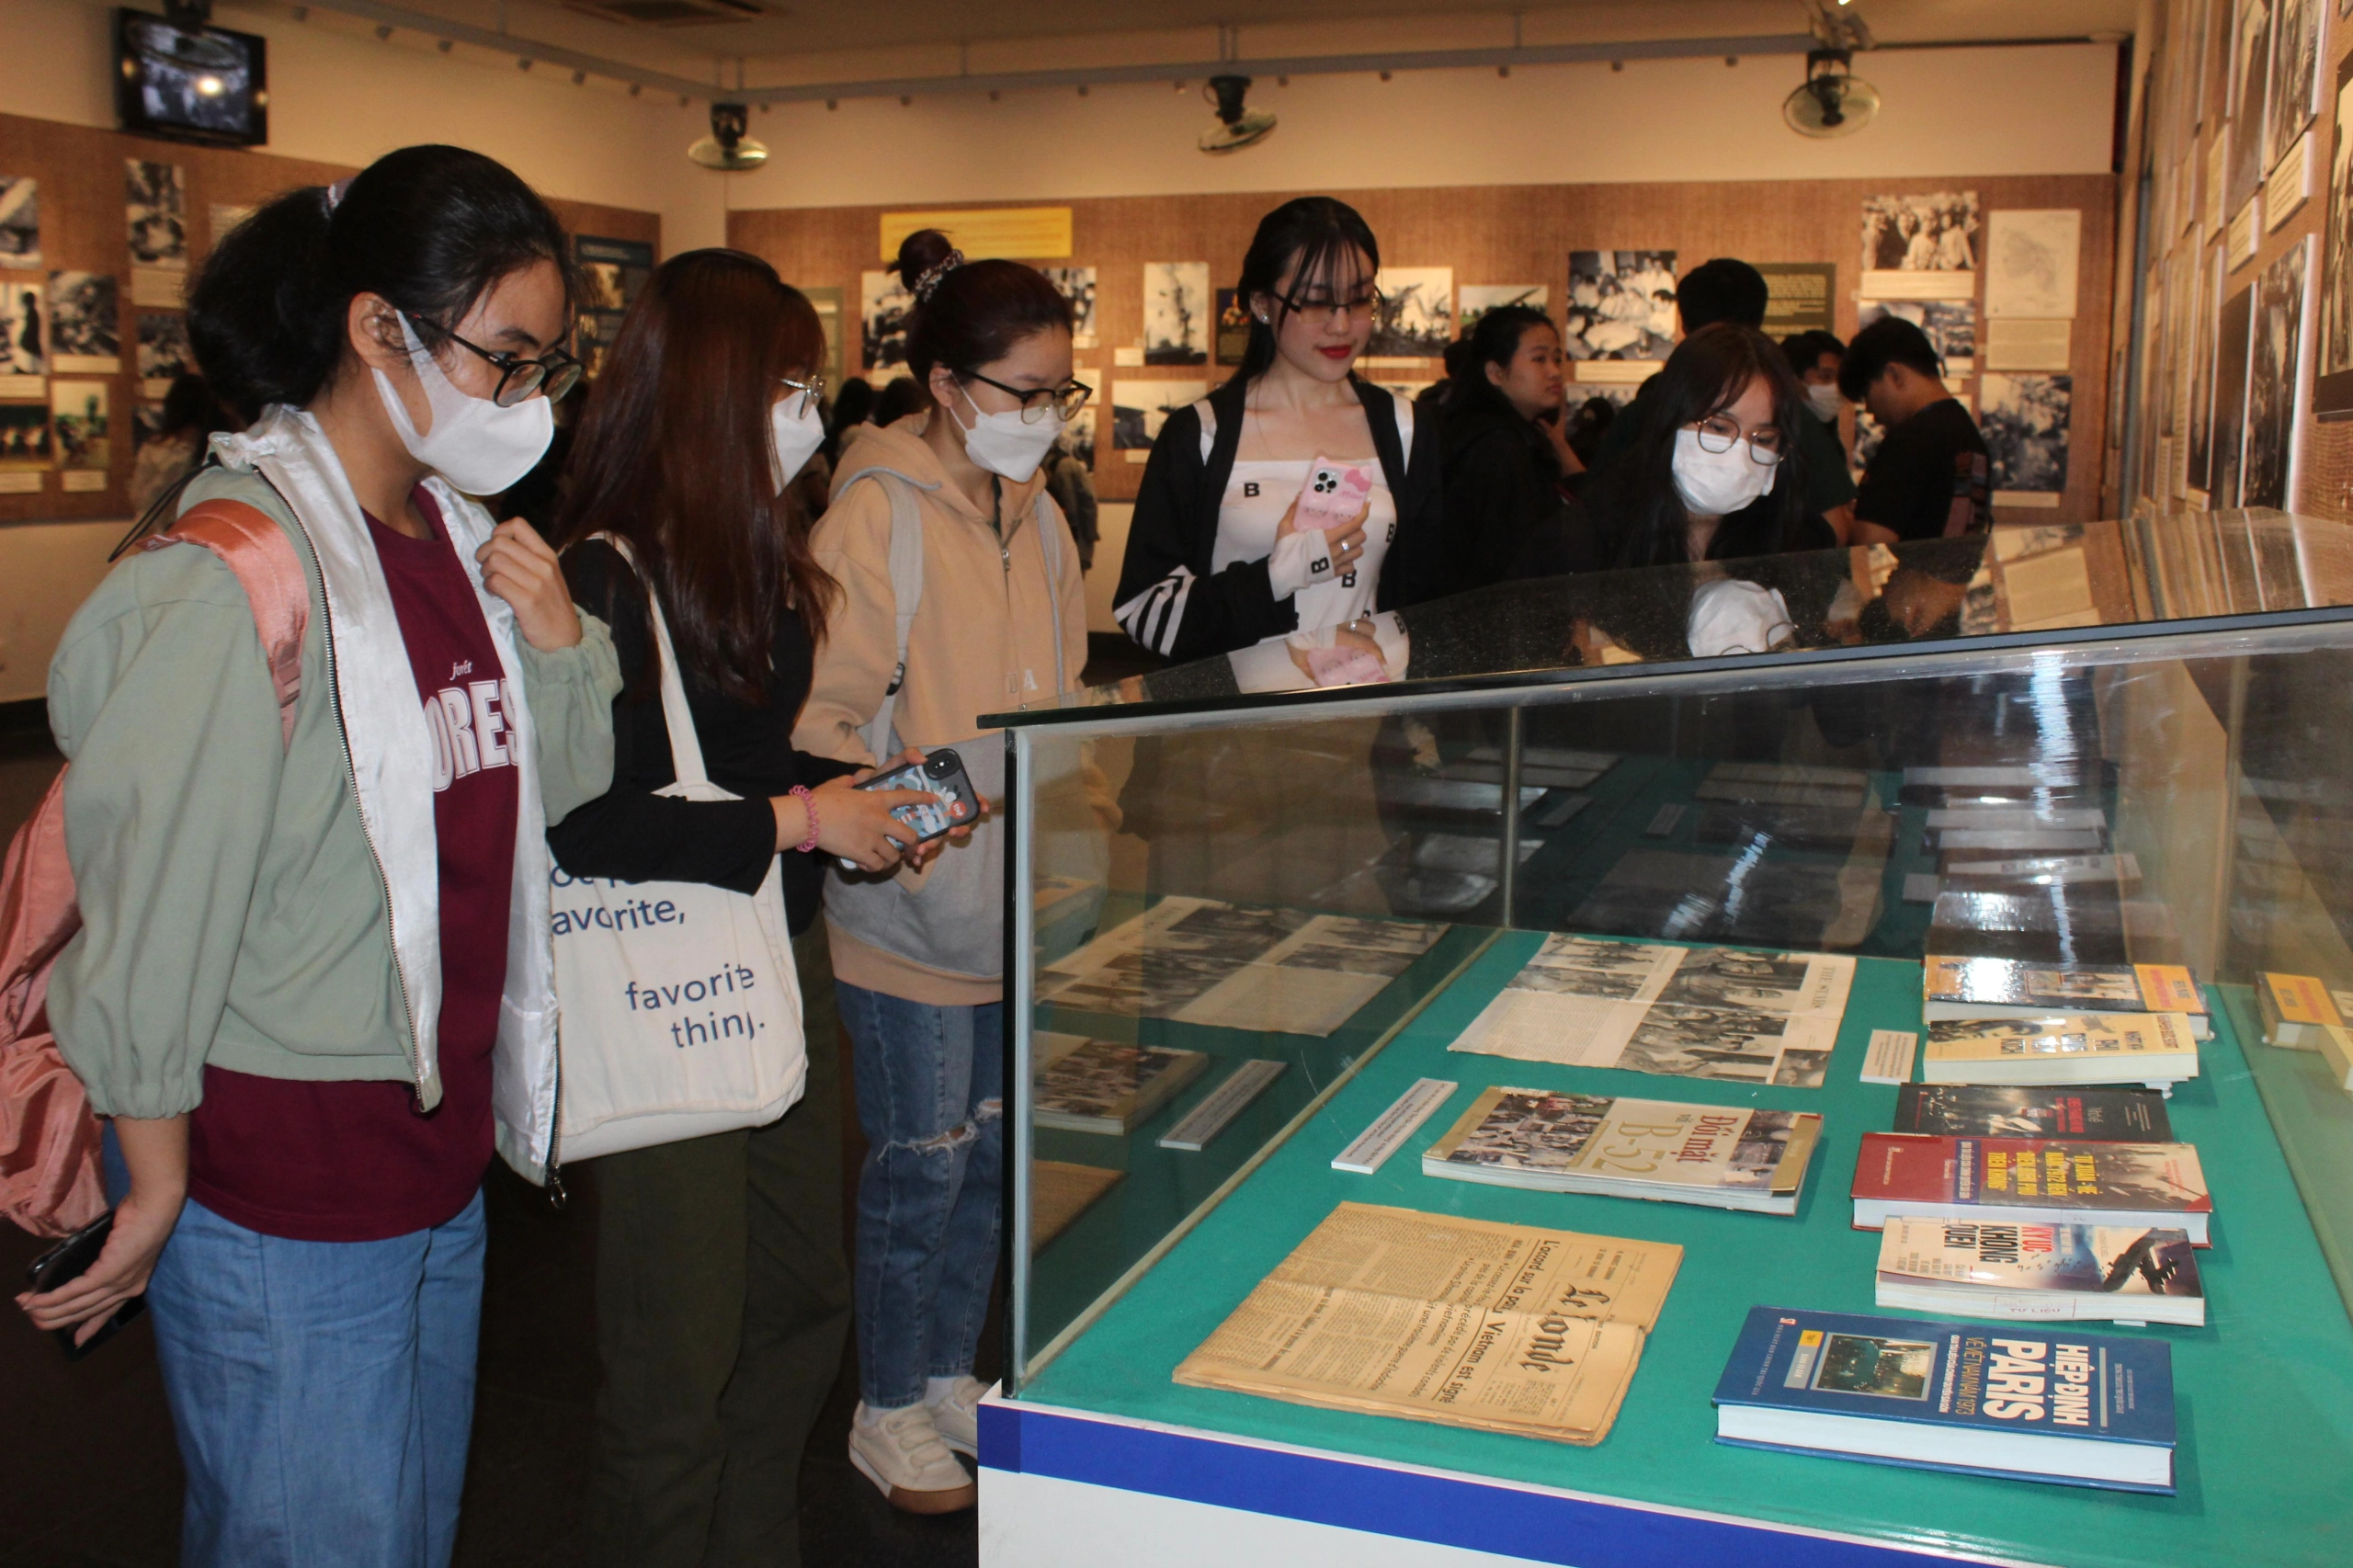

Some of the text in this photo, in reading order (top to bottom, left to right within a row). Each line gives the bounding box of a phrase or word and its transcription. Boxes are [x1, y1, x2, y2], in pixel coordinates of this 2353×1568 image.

[1244, 483, 1260, 497] B
[1311, 557, 1329, 574] B
[551, 900, 686, 935] avorite,
[1591, 1121, 1685, 1174] B-52
[1670, 1116, 1739, 1164] Đối mặt
[1979, 1226, 2019, 1264] KHÔNG
[1519, 1272, 1536, 1285] sur
[1512, 1287, 1532, 1295] la
[1559, 1285, 1611, 1308] Le
[1466, 1323, 1506, 1364] Vietnam
[1518, 1310, 1599, 1372] onde
[1962, 1347, 1985, 1364] VIỆT
[1456, 1367, 1474, 1380] est
[1961, 1362, 1982, 1381] NAM
[1982, 1338, 2047, 1420] PARIS
[1438, 1382, 1467, 1404] signé
[1958, 1380, 1981, 1399] NĂM
[2047, 1344, 2096, 1426] HIỆP ĐỊNH
[1954, 1399, 1976, 1415] 1973
